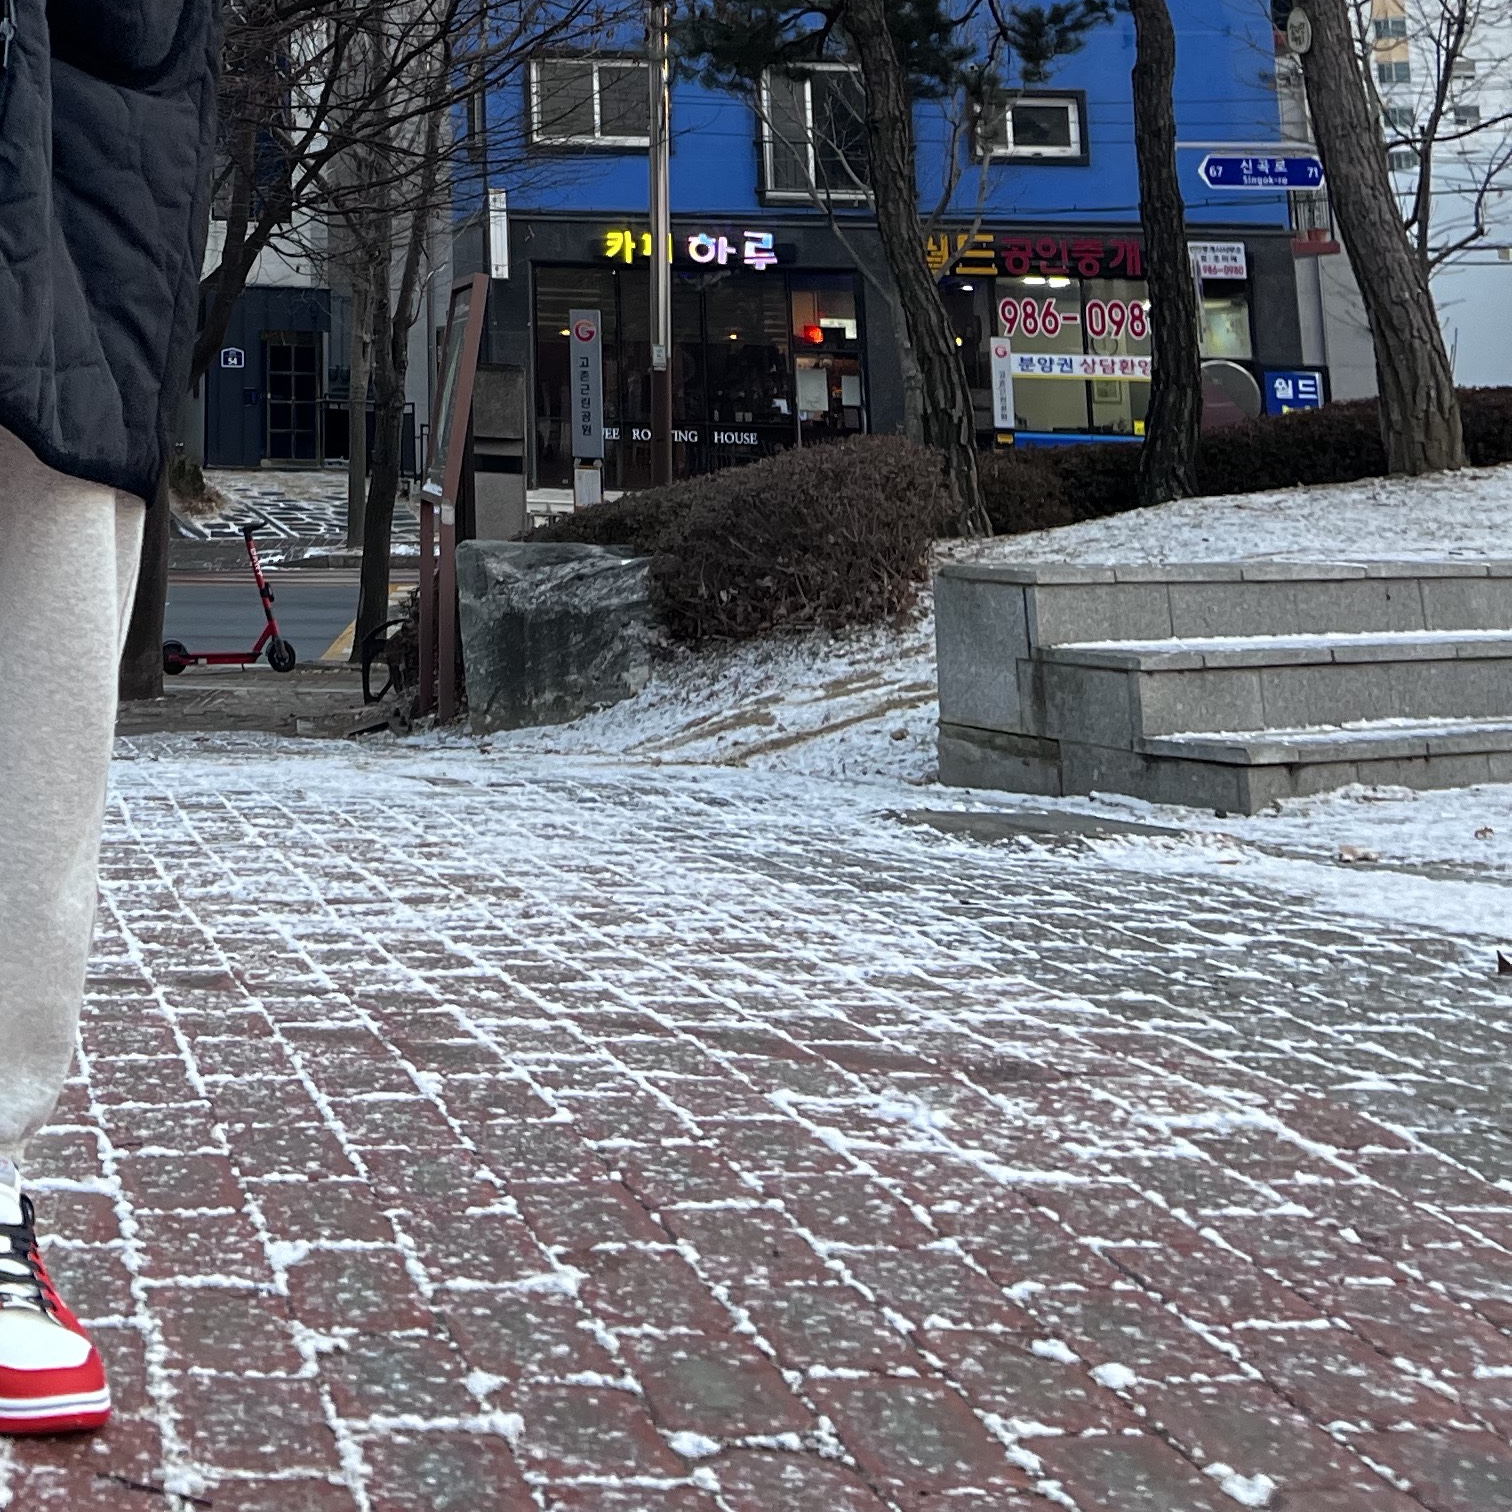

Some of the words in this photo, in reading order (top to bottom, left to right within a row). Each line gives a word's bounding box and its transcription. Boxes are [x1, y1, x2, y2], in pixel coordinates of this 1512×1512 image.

[1209, 166, 1223, 178] 67
[1306, 167, 1319, 179] 71
[687, 230, 778, 271] 하루
[714, 431, 758, 445] HOUSE
